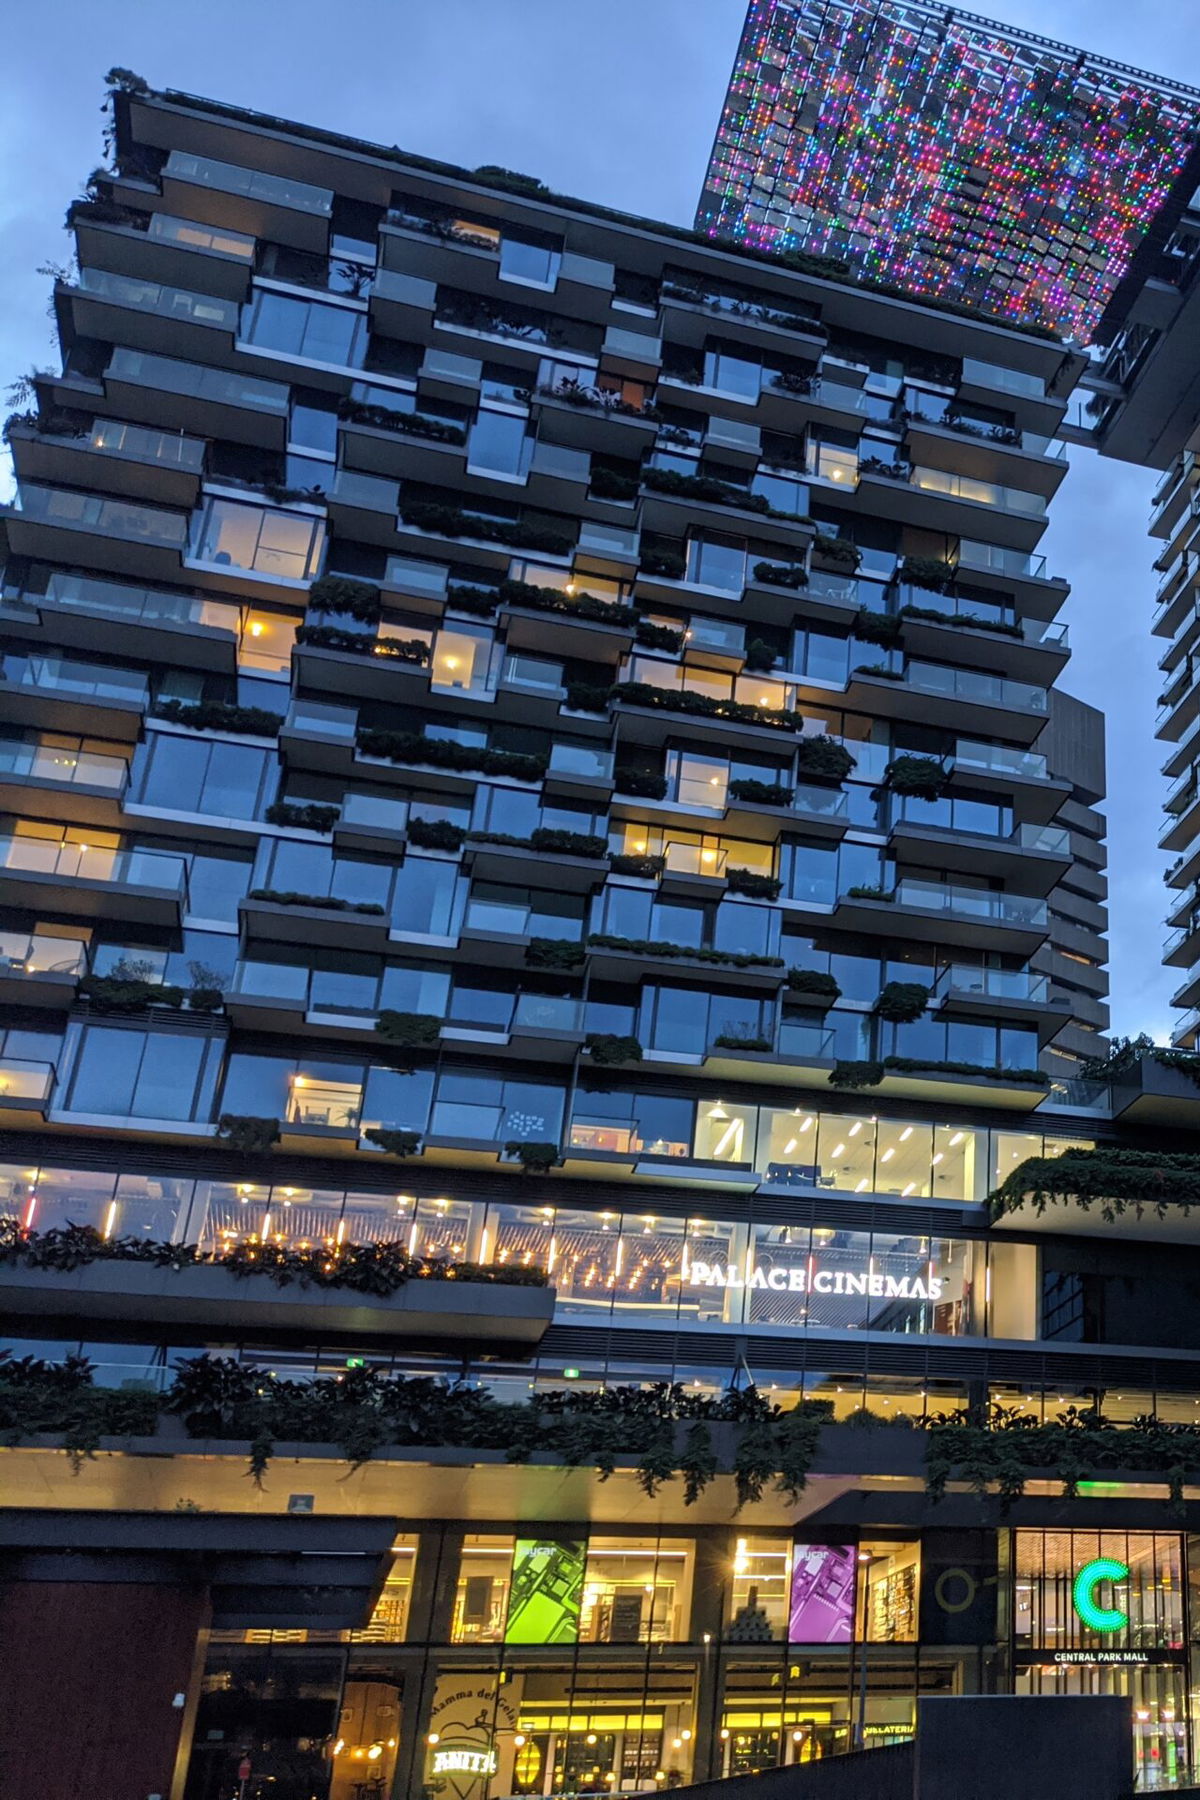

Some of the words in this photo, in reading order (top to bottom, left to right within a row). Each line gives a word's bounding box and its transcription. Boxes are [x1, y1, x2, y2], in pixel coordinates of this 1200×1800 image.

[690, 1262, 806, 1292] PALACE
[813, 1271, 943, 1301] CINEMAS
[1073, 1557, 1129, 1632] C
[1053, 1652, 1097, 1662] CENTRAL
[1097, 1652, 1122, 1662] PARK
[1122, 1652, 1149, 1661] MALL
[433, 1751, 496, 1773] ANITA
